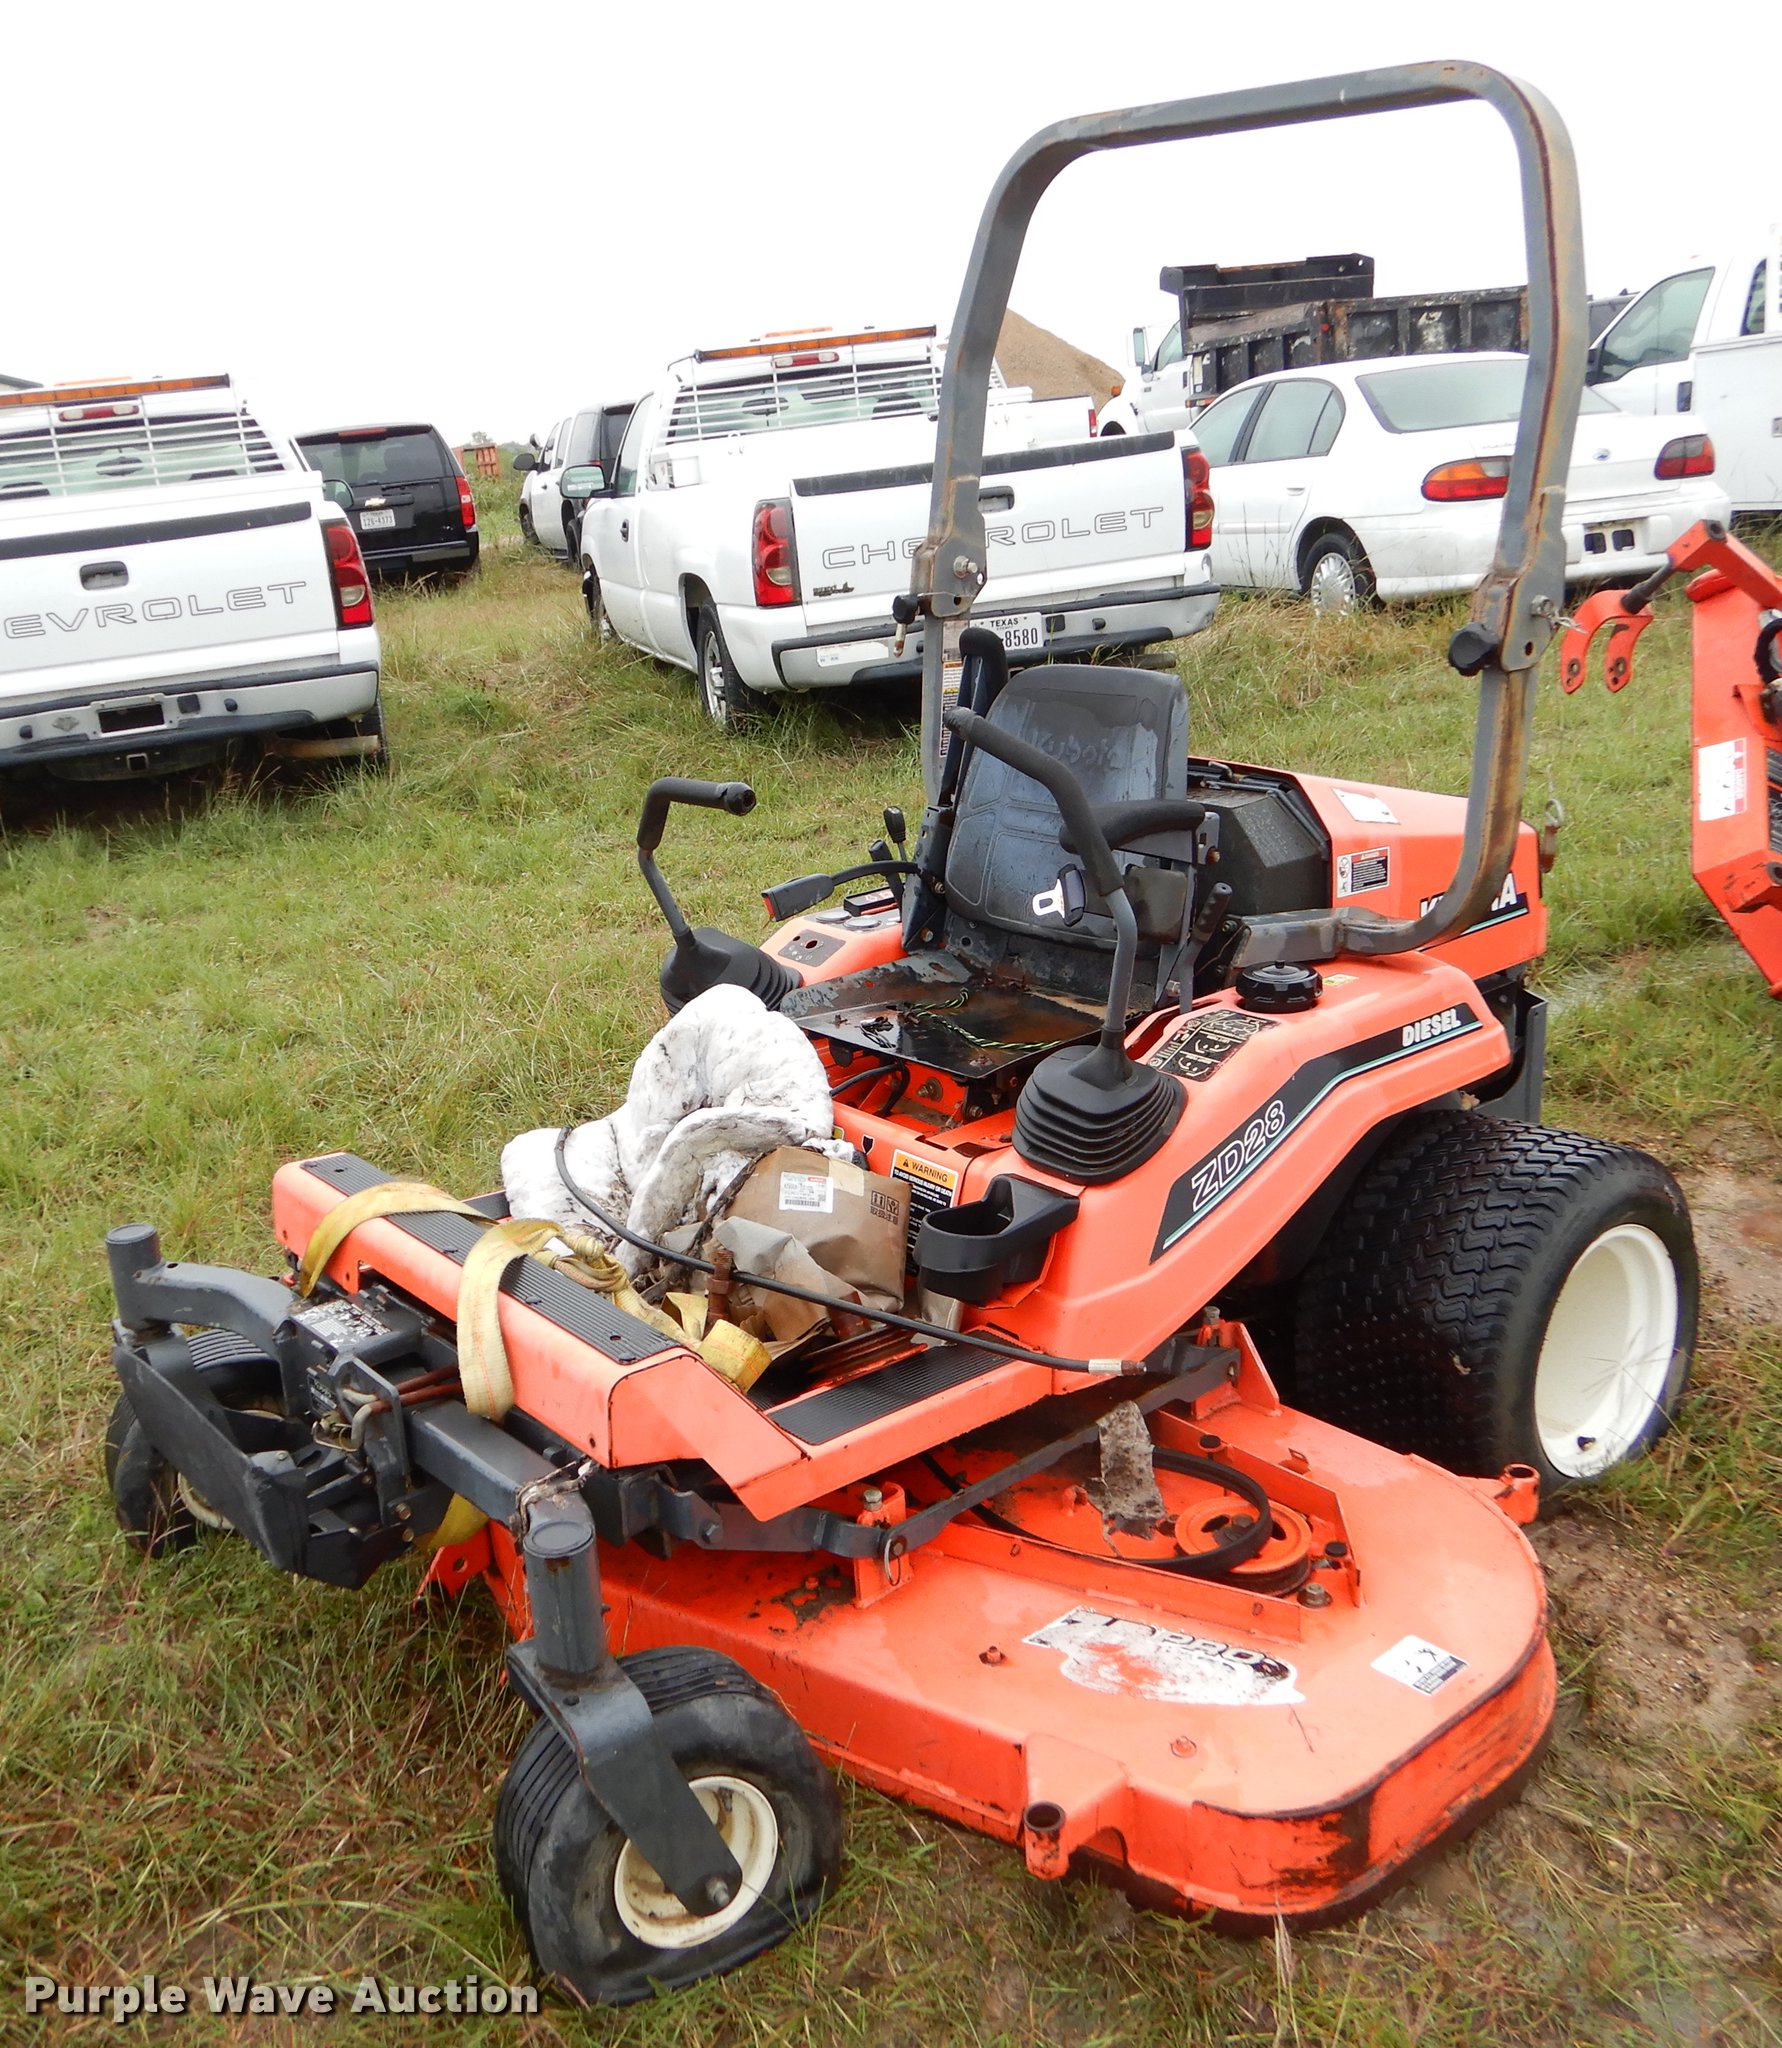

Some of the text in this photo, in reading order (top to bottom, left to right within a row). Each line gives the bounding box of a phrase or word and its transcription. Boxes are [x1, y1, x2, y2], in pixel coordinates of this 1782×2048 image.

[822, 506, 1164, 570] CHEROLET
[4, 581, 306, 639] EVROLET
[990, 617, 1019, 628] TEXAS
[1401, 1008, 1462, 1048] DIESEL
[912, 1161, 948, 1183] WARNING
[1191, 1099, 1286, 1213] ZD28
